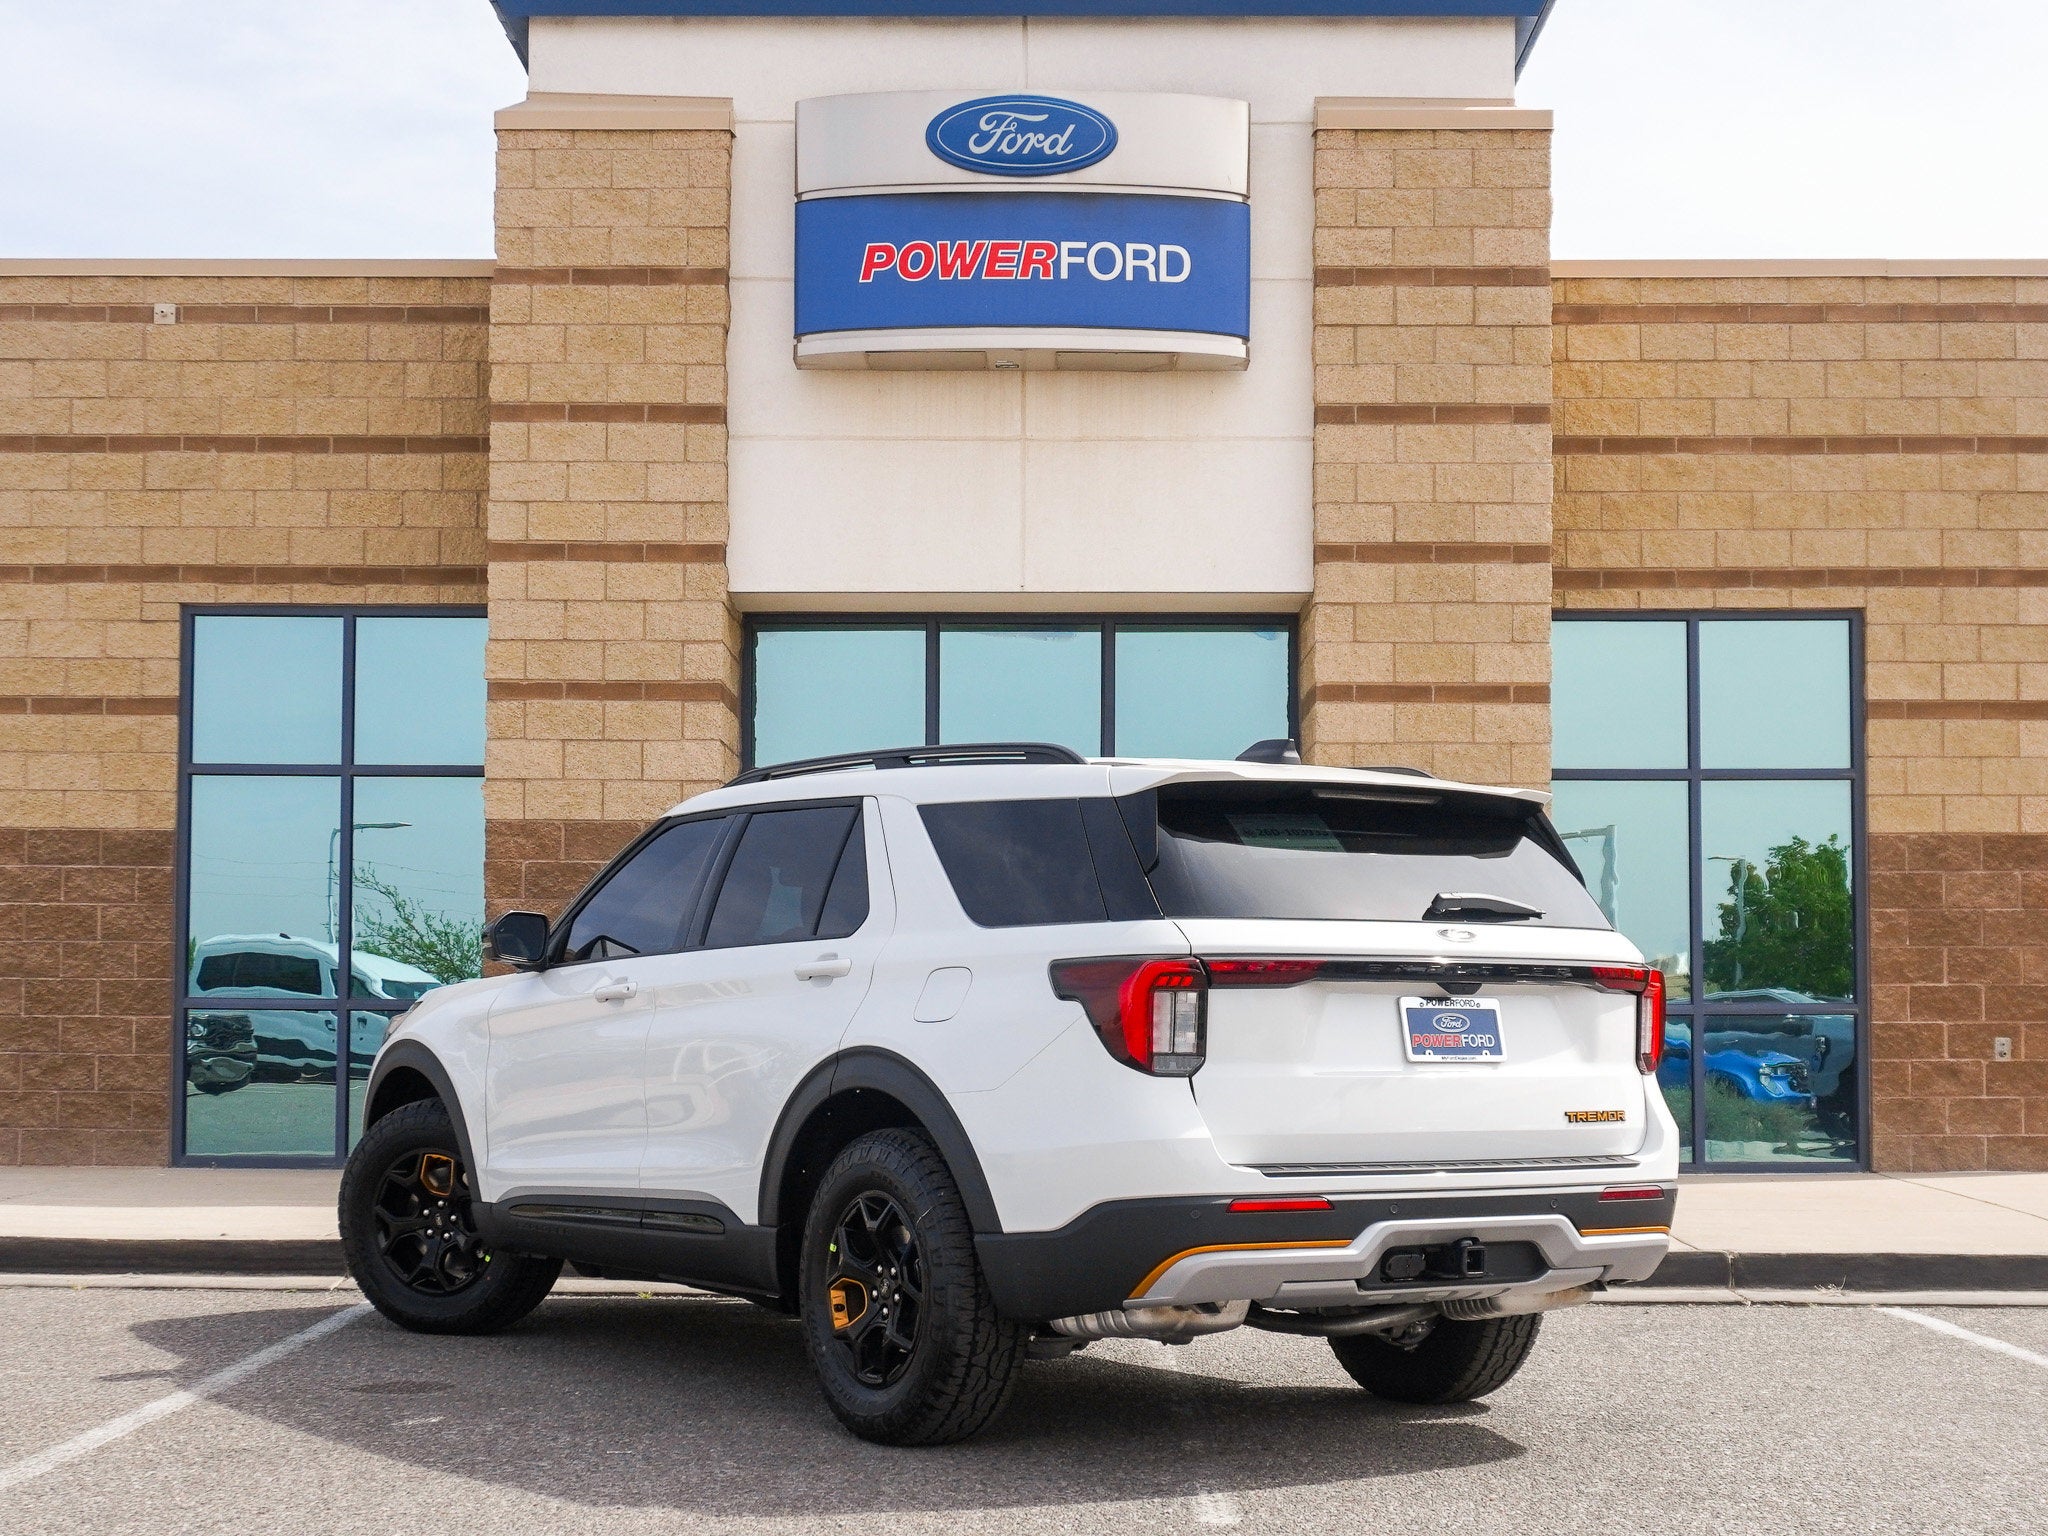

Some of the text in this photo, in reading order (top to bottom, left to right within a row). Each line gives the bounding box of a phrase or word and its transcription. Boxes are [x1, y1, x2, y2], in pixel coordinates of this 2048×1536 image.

[968, 111, 1075, 157] Ford
[858, 240, 1192, 284] POWERFORD
[1425, 999, 1476, 1007] POWERFORD
[1440, 1016, 1463, 1028] Ford
[1411, 1033, 1496, 1048] POWERFORD
[1564, 1110, 1626, 1123] TREMOR
